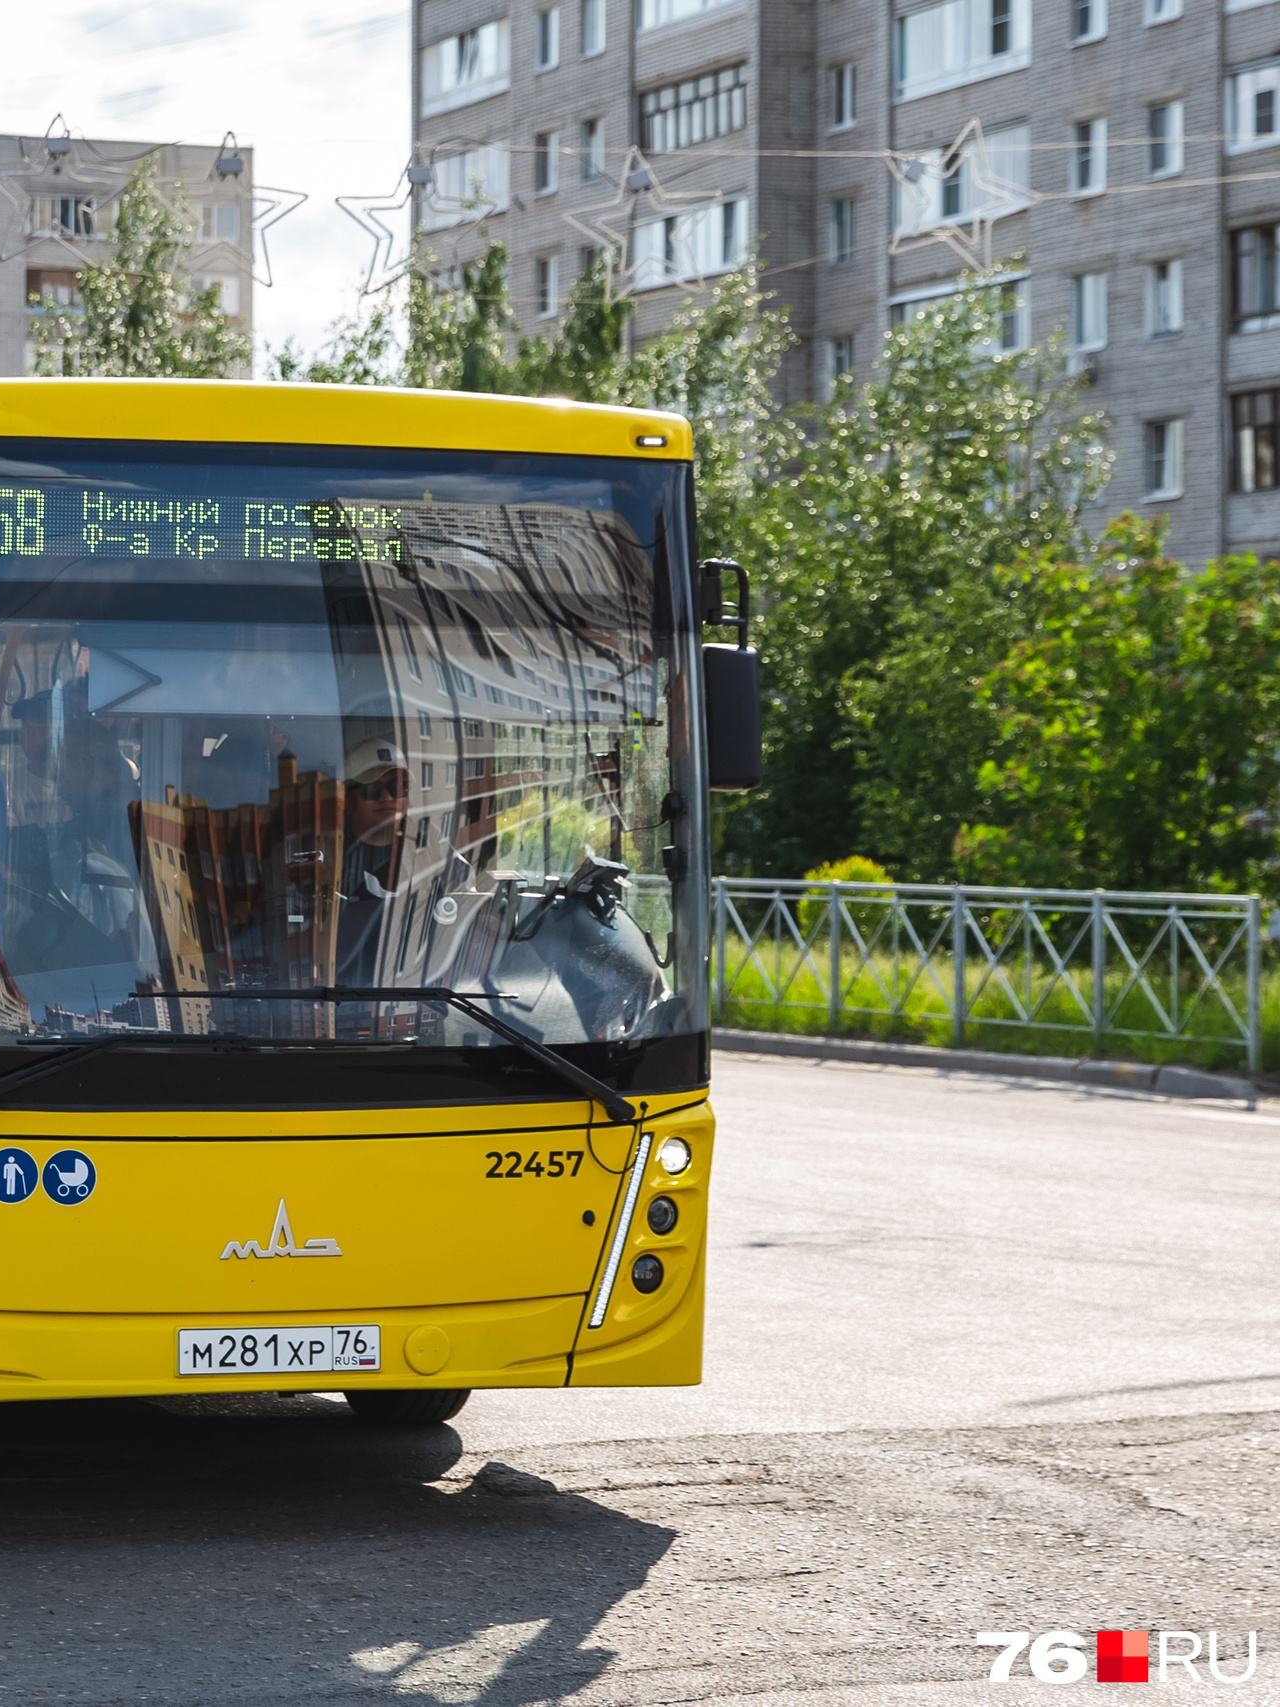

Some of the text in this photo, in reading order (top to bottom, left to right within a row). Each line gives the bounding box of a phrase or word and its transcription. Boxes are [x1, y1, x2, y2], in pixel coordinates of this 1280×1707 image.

[82, 491, 402, 530] Нижний поселок
[82, 523, 402, 563] Ф-а Кр Перевал
[485, 1151, 584, 1178] 22457
[192, 1330, 367, 1368] М281ХР 76
[335, 1356, 358, 1366] RUS
